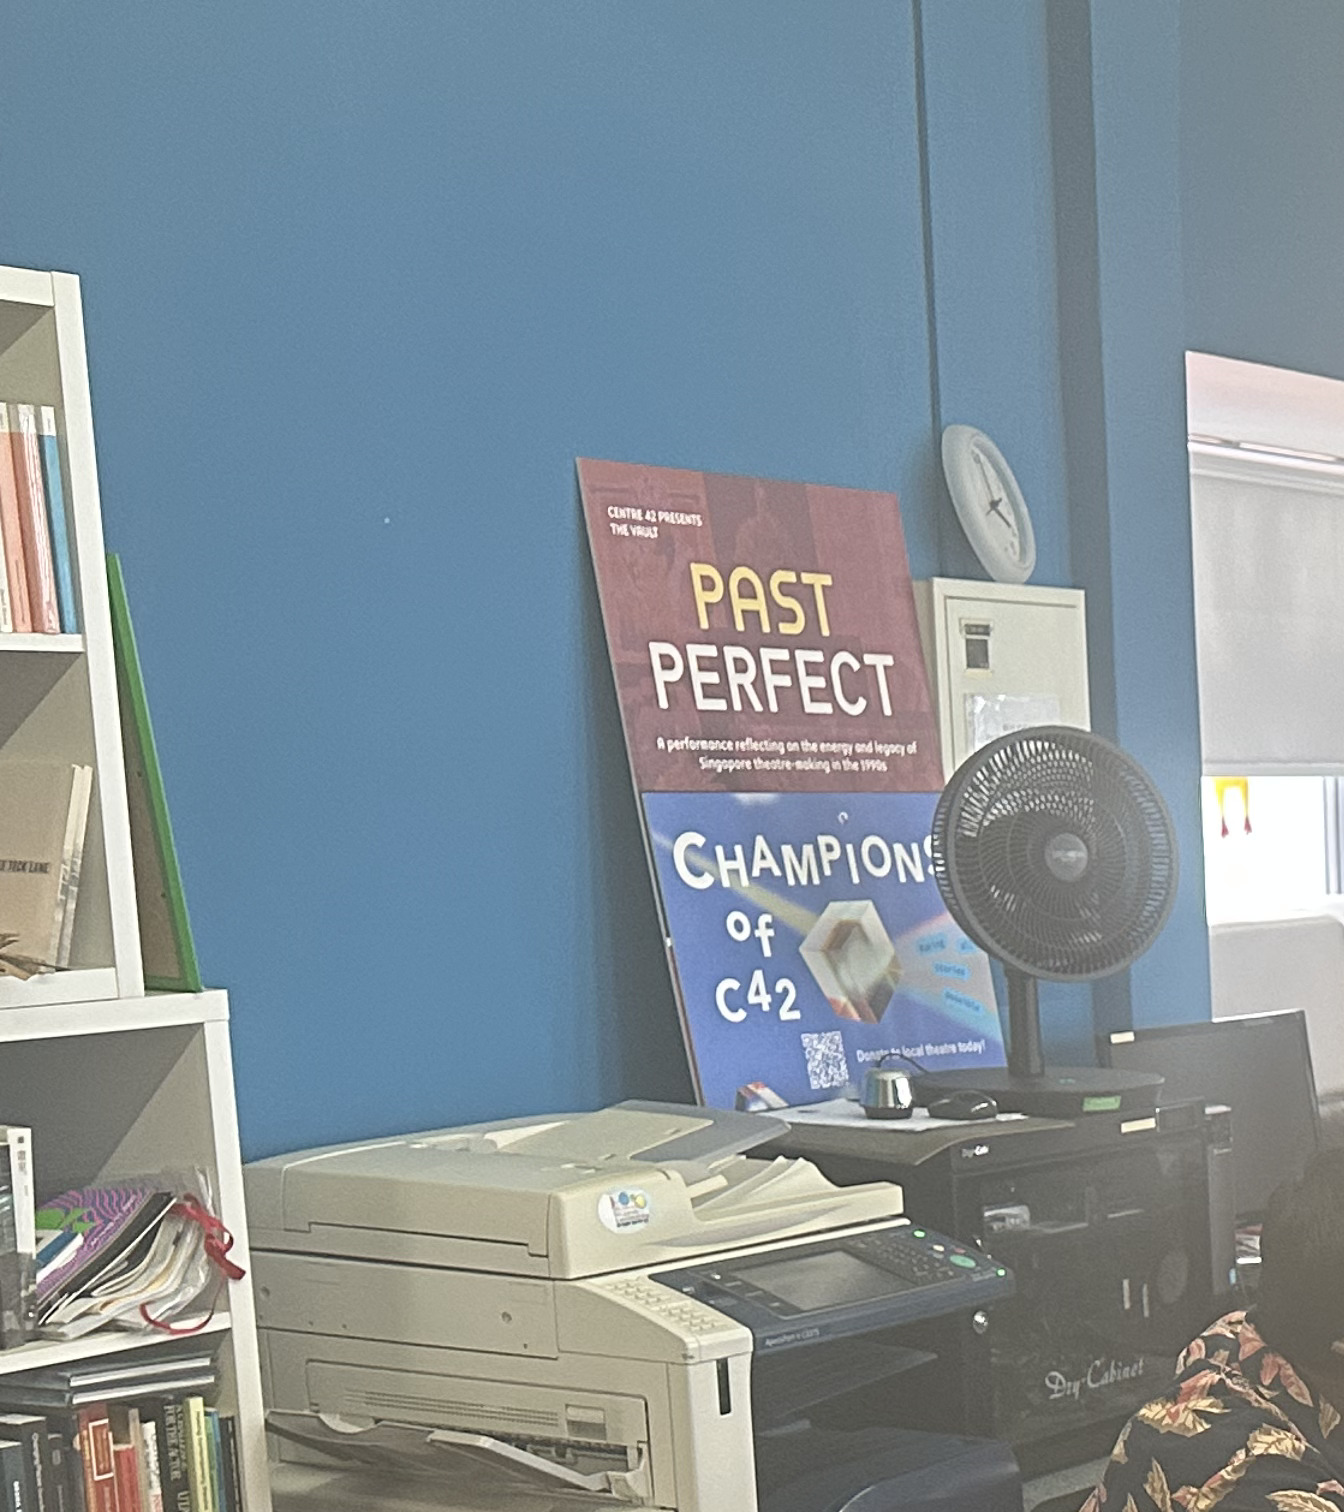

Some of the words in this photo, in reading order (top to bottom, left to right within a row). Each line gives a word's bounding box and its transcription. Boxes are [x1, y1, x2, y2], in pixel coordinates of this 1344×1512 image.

[608, 506, 643, 521] CENTRE
[658, 511, 703, 526] PRESENTS
[610, 523, 629, 536] THE
[630, 525, 658, 538] VAULT
[690, 562, 832, 637] PAST
[649, 642, 894, 716] PERFECT
[657, 737, 665, 749] A
[667, 738, 734, 753] performance
[735, 738, 784, 754] reflecting
[787, 742, 799, 752] on
[801, 741, 818, 753] the
[820, 742, 852, 757] energy
[855, 742, 873, 753] and
[875, 742, 906, 757] legacy
[907, 742, 917, 754] of
[700, 757, 752, 773] Singapore
[754, 758, 830, 774] theatre-making
[832, 760, 842, 771] in
[843, 759, 859, 772] the
[860, 760, 888, 772] 1990s
[726, 911, 774, 957] of
[715, 970, 801, 1022] C42
